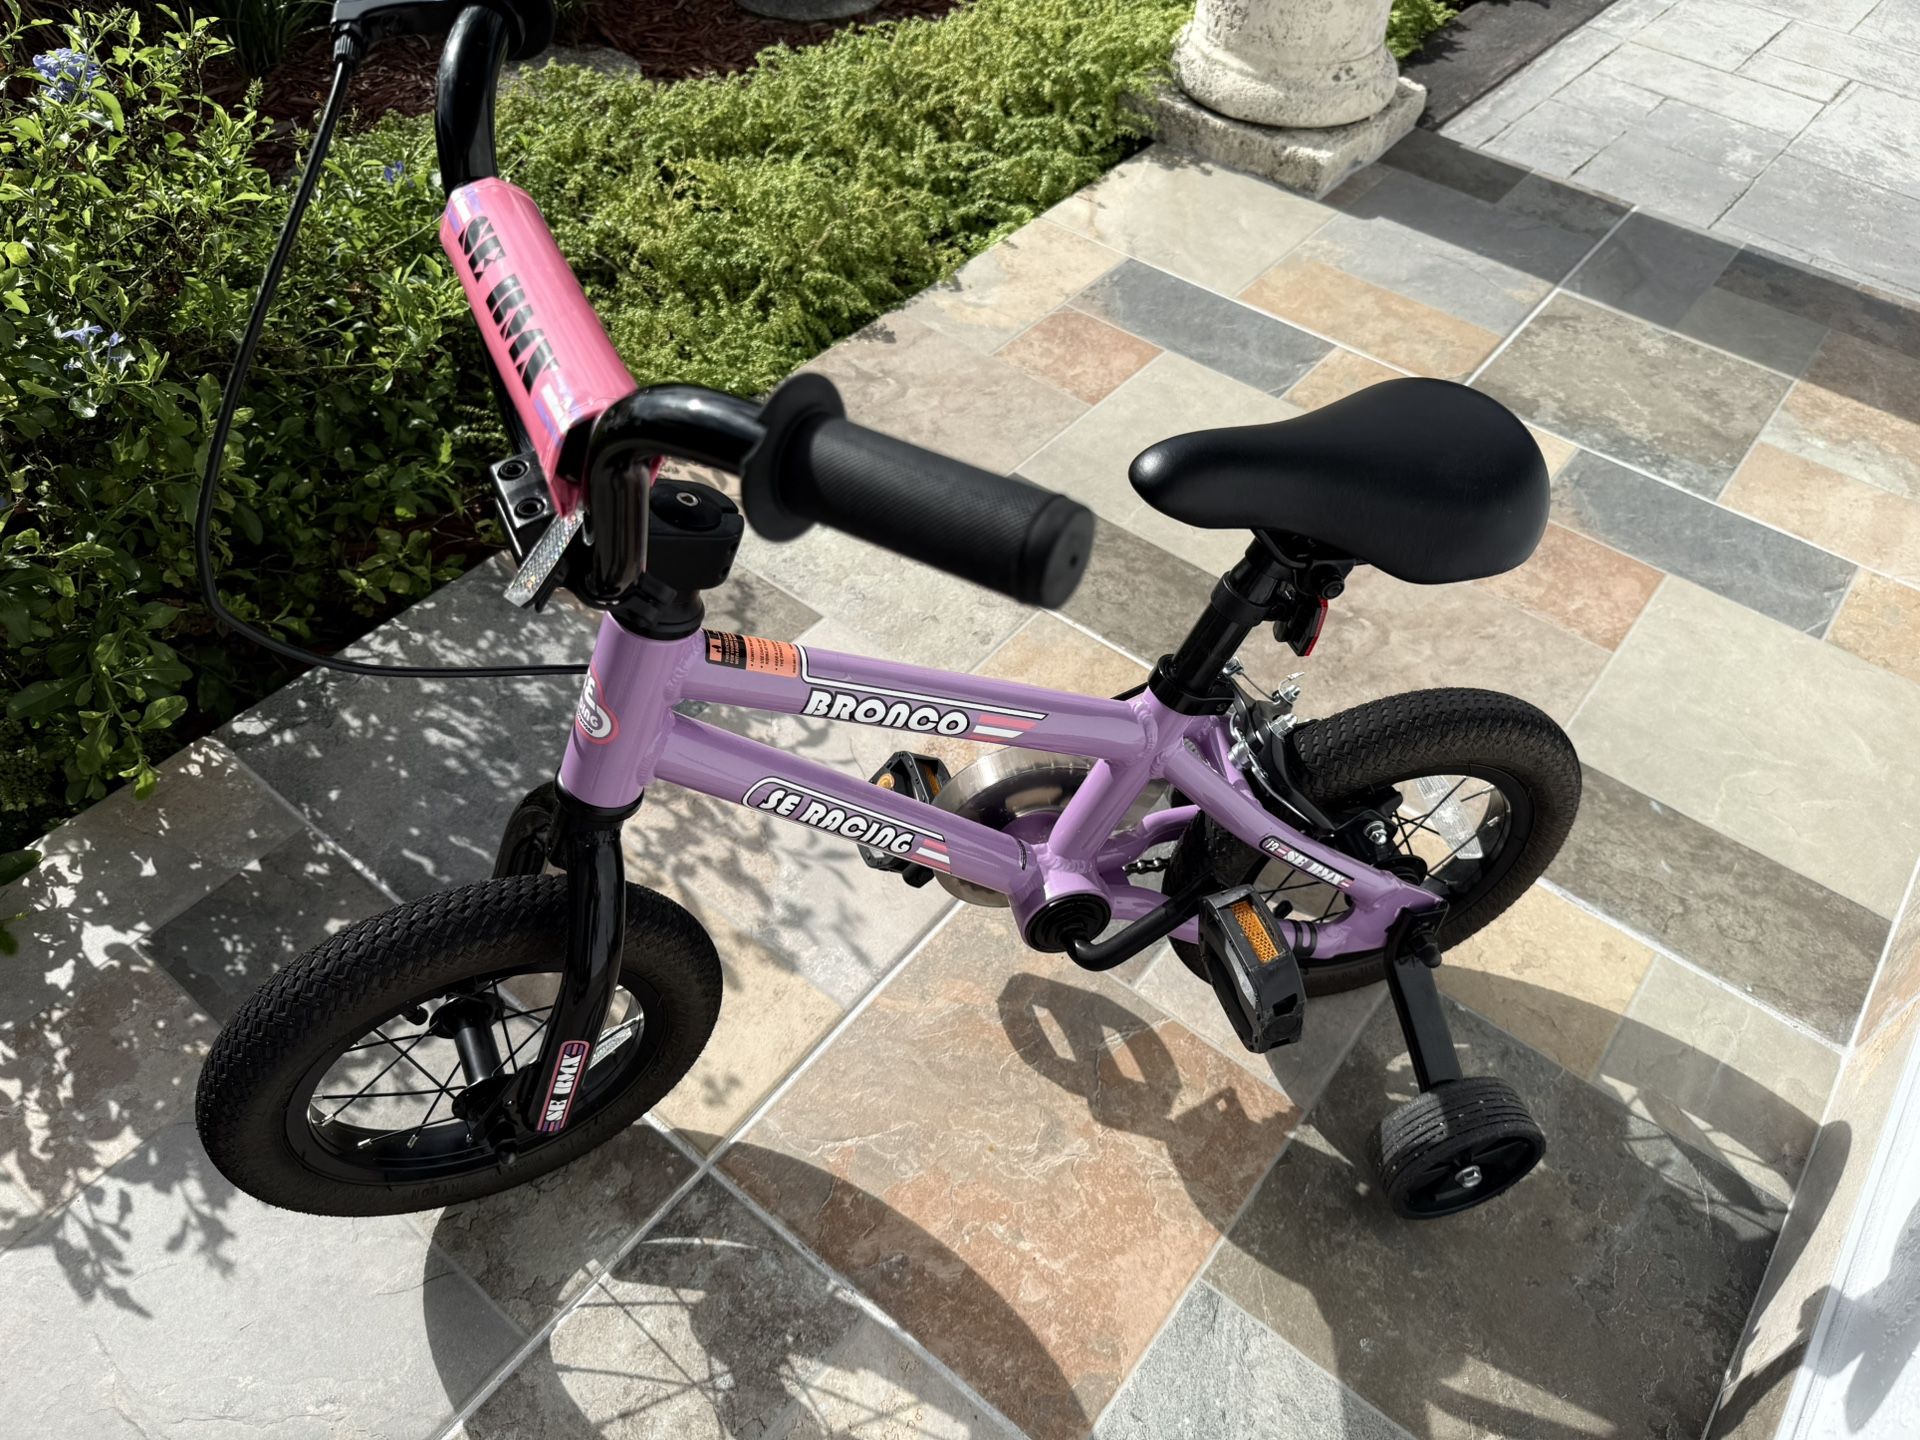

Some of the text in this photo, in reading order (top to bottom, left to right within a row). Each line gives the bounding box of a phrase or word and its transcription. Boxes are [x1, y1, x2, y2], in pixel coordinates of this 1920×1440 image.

[458, 216, 506, 283] SE
[802, 688, 970, 735] BRONCO
[759, 788, 915, 854] SE RACING
[1283, 850, 1308, 867] SE
[546, 1099, 568, 1122] SE
